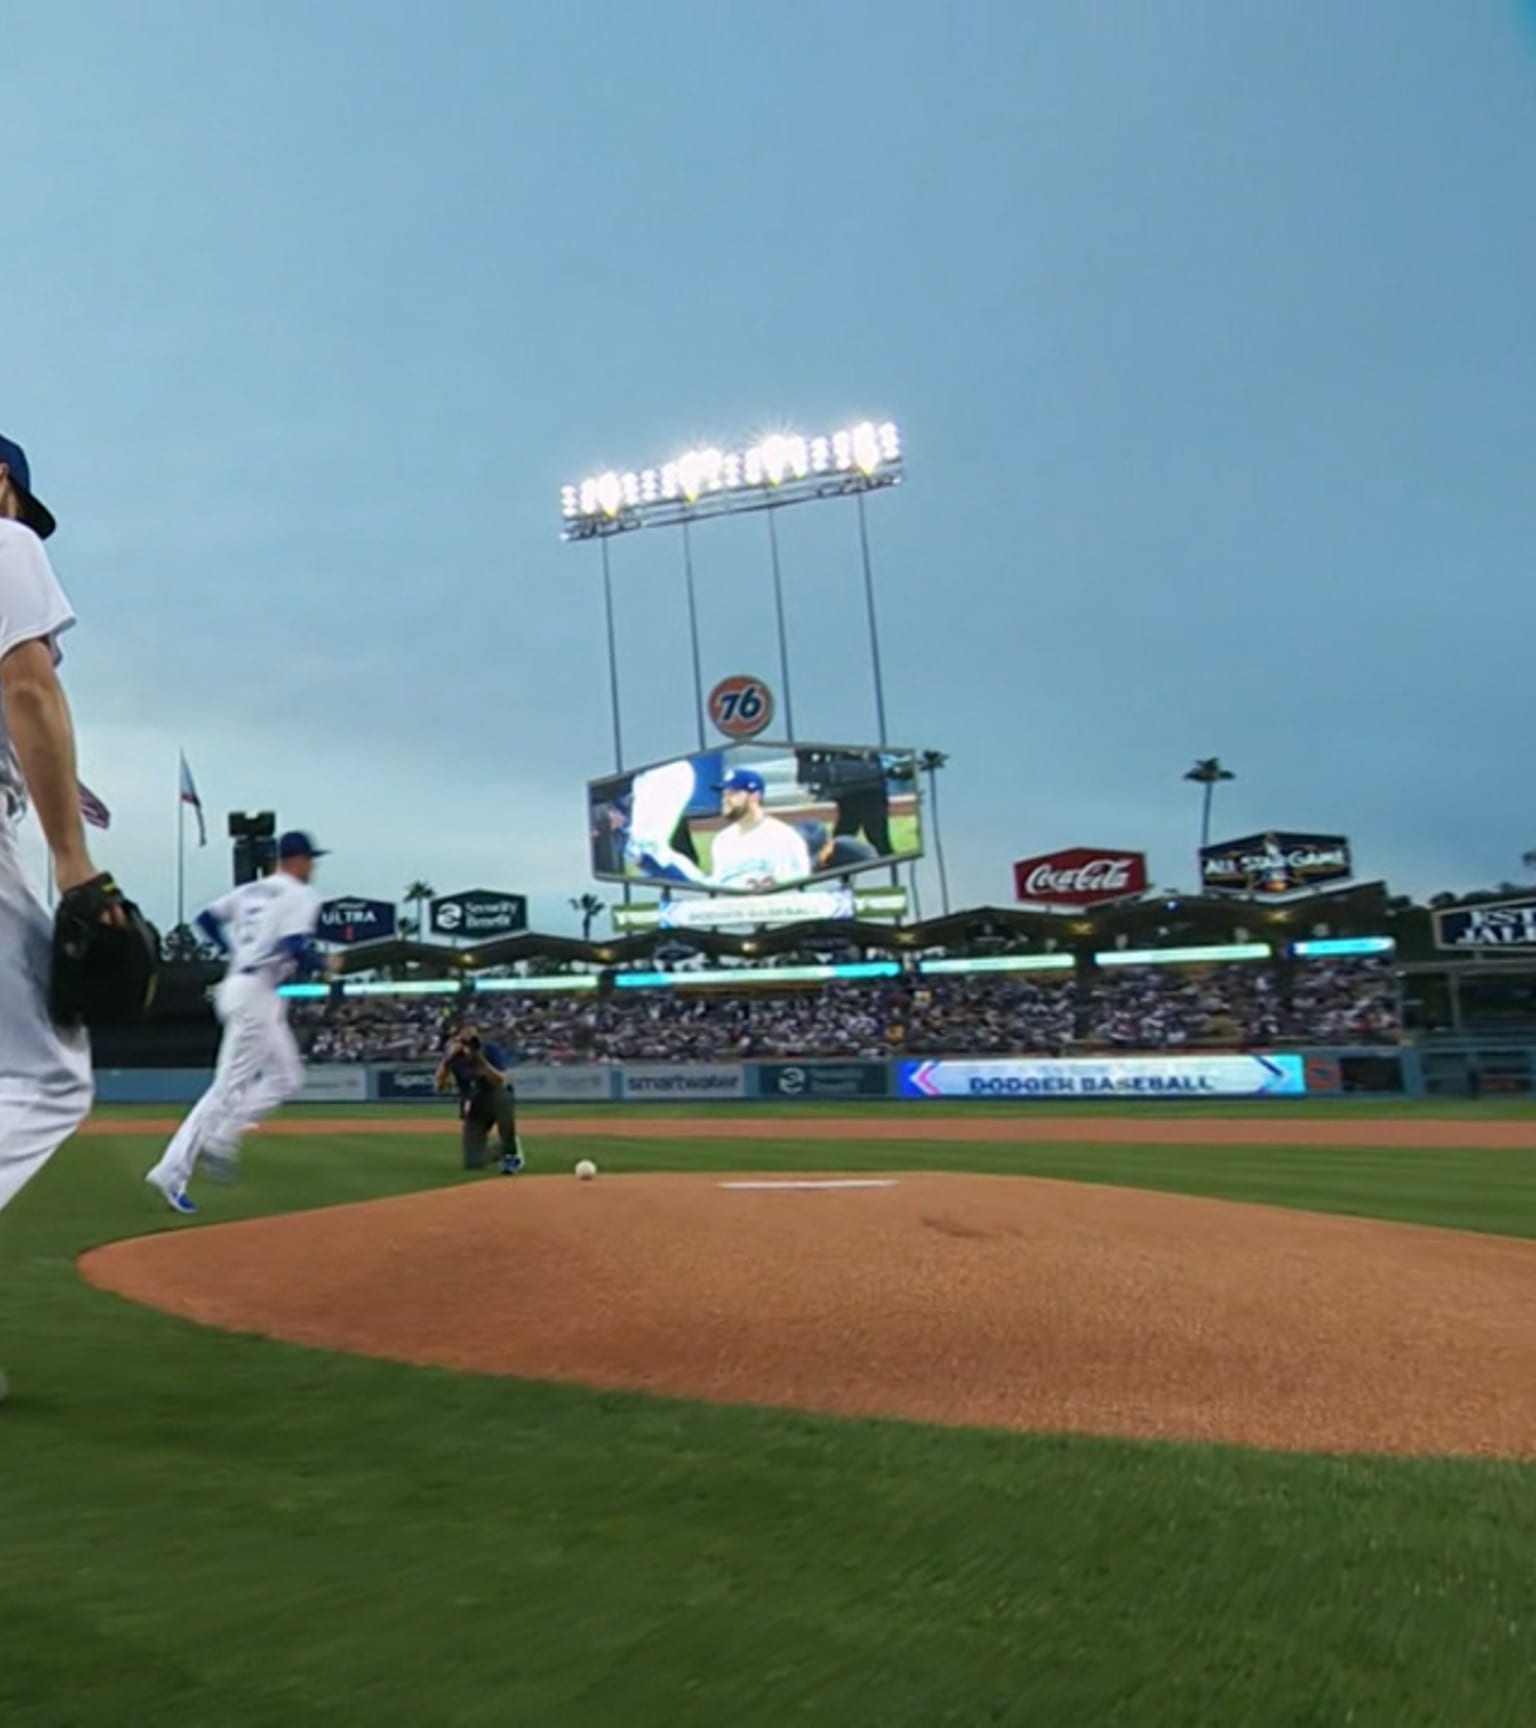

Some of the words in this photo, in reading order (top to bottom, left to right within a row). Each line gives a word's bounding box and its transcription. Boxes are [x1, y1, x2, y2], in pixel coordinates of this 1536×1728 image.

[721, 686, 762, 720] 76
[322, 909, 377, 924] ULTRA
[628, 1074, 740, 1091] smartwater
[969, 1076, 1073, 1092] DODGER
[1080, 1075, 1214, 1091] BASEBALL
